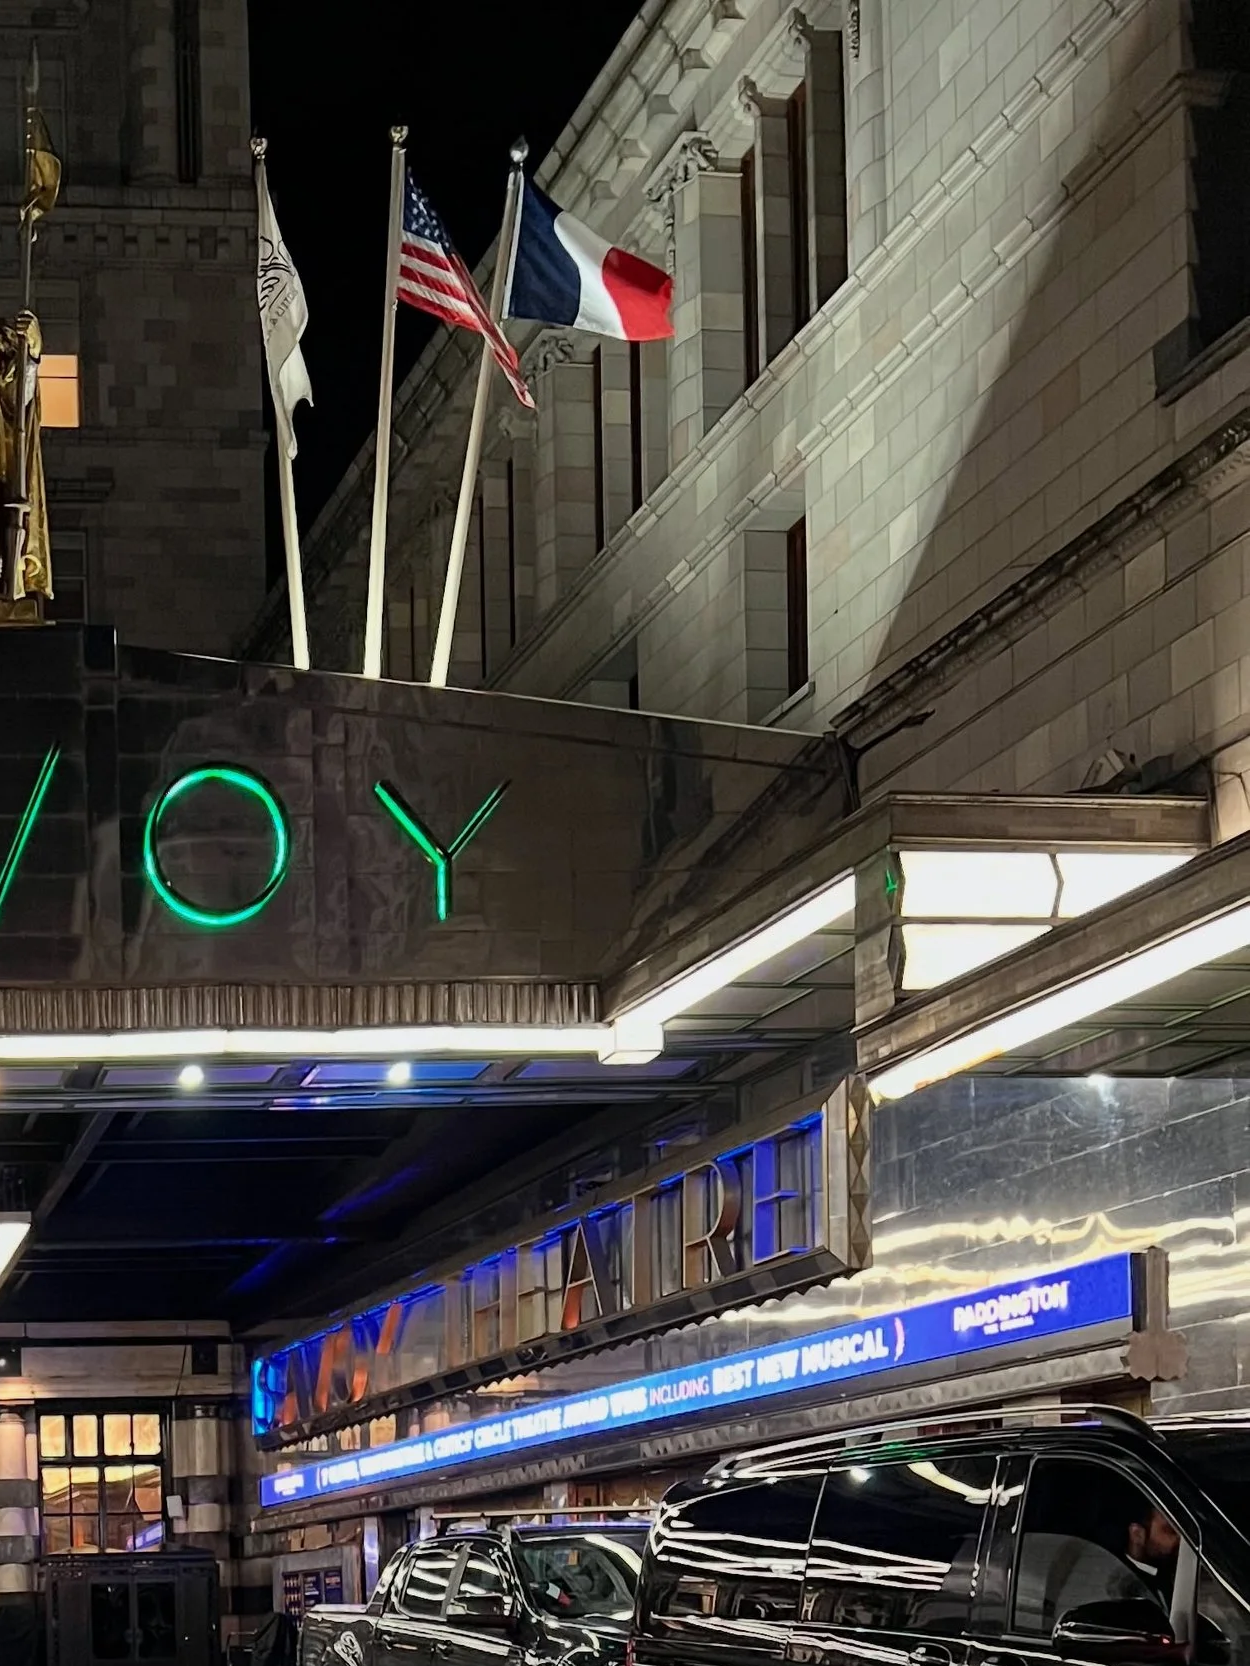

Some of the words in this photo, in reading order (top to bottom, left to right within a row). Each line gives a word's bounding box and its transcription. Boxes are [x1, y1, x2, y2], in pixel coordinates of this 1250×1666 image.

[953, 1280, 1070, 1333] PADDINGTON
[649, 1376, 709, 1405] INCLUDING
[712, 1360, 755, 1395] BEST
[757, 1349, 799, 1385] NEW
[802, 1328, 889, 1375] MUSICAL
